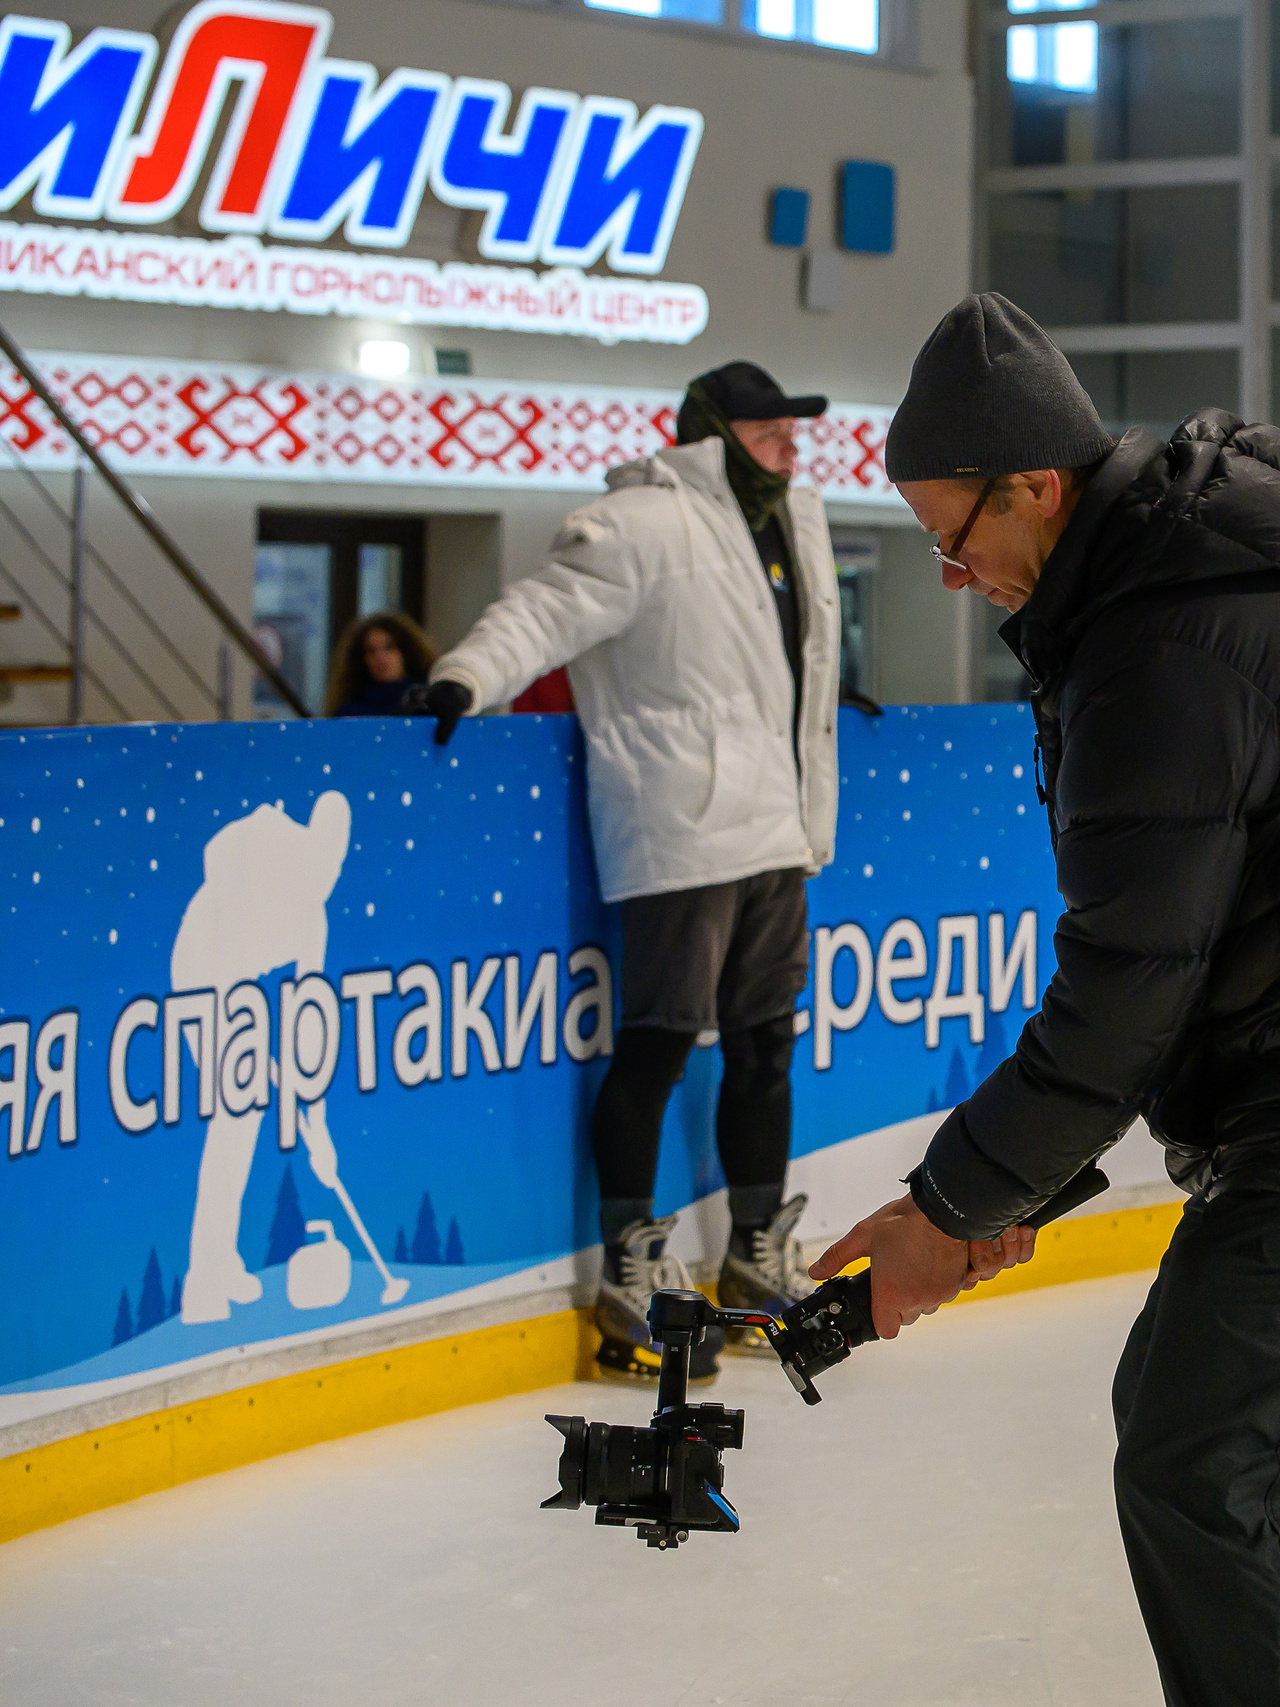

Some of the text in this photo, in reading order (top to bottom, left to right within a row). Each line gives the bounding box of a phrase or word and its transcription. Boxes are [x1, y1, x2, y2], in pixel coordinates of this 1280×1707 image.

[0, 236, 699, 330] ИКАНСКИЙ ГОРНОЛЫЖНЫЙ ЦЕНТР
[107, 945, 720, 1150] спартакиа
[793, 909, 1038, 1071] реди
